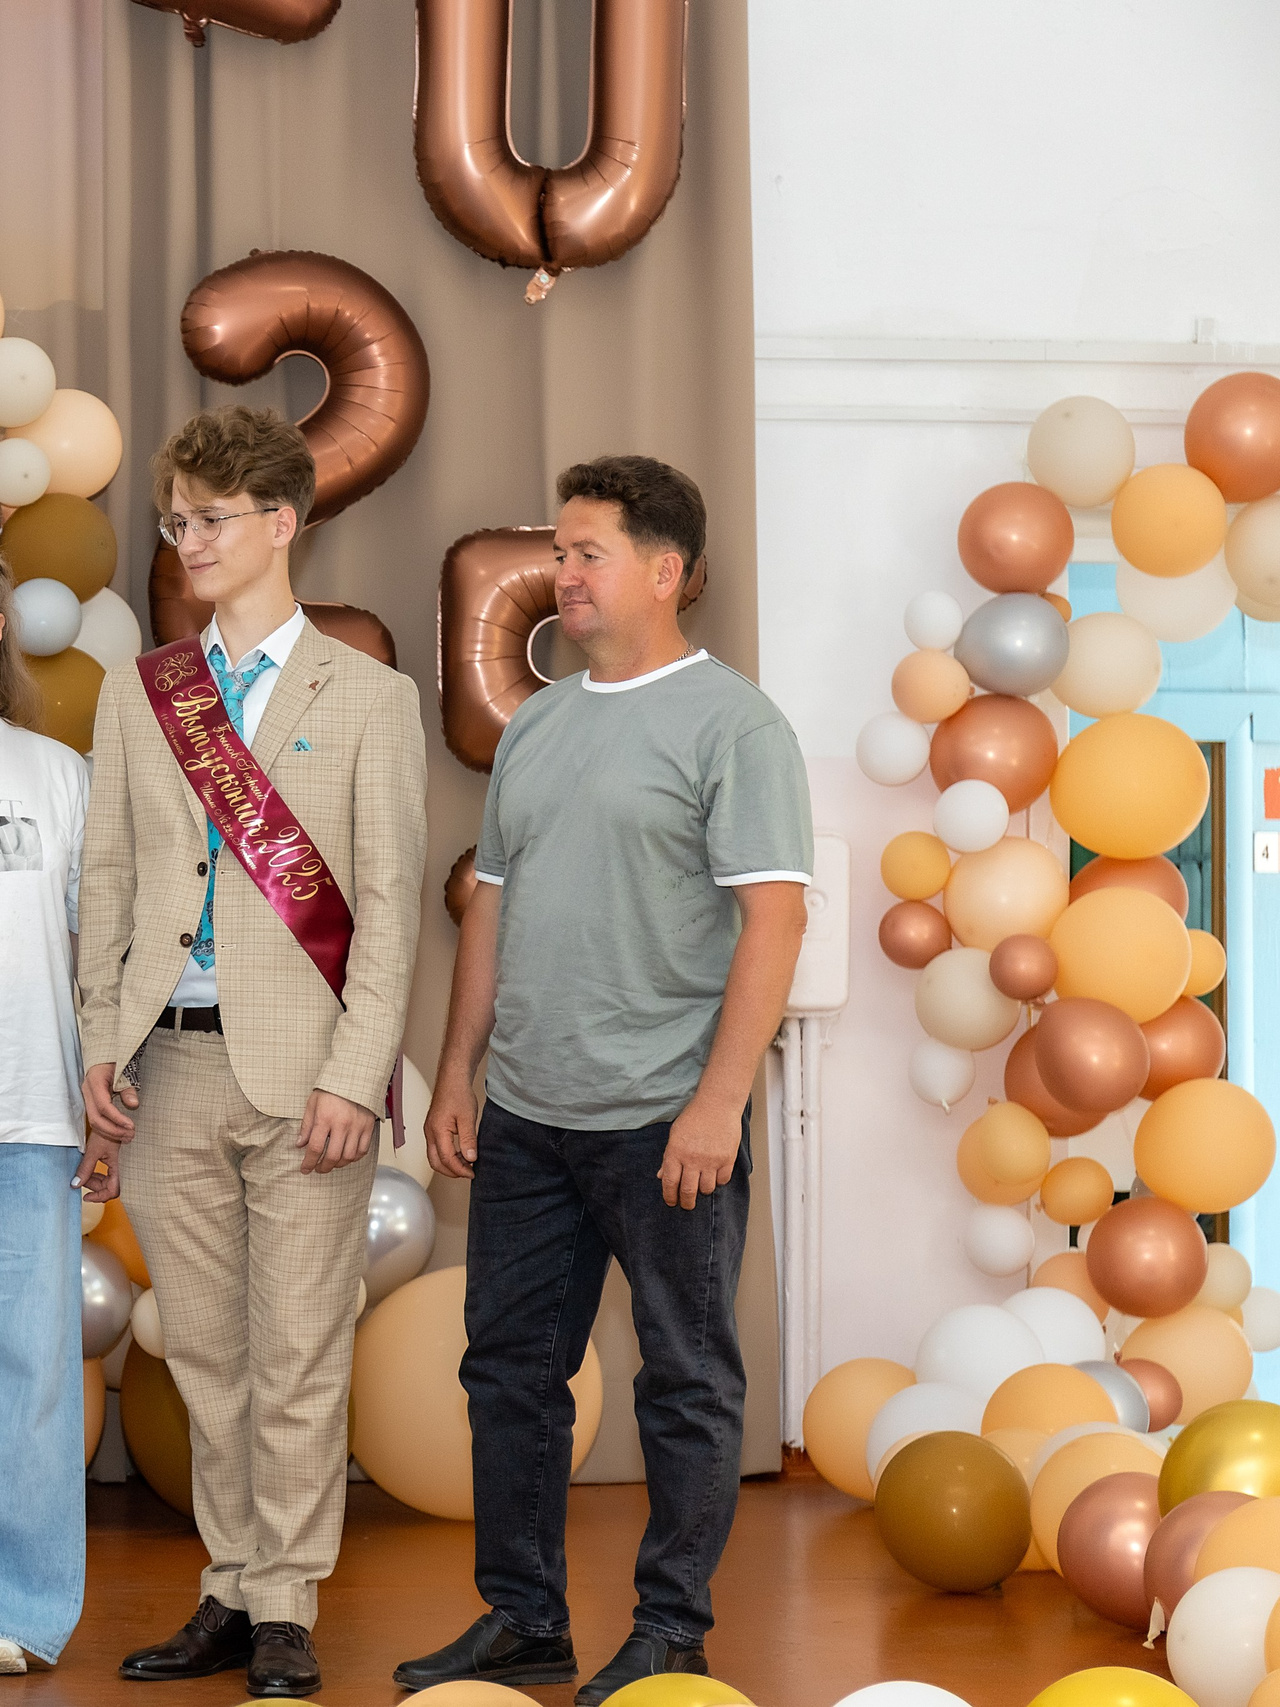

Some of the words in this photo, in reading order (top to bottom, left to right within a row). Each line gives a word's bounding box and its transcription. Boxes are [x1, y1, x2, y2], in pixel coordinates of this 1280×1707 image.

[171, 685, 269, 837] Выпускник
[253, 826, 333, 900] 2025
[213, 721, 245, 759] Быков
[236, 759, 269, 801] Георгий
